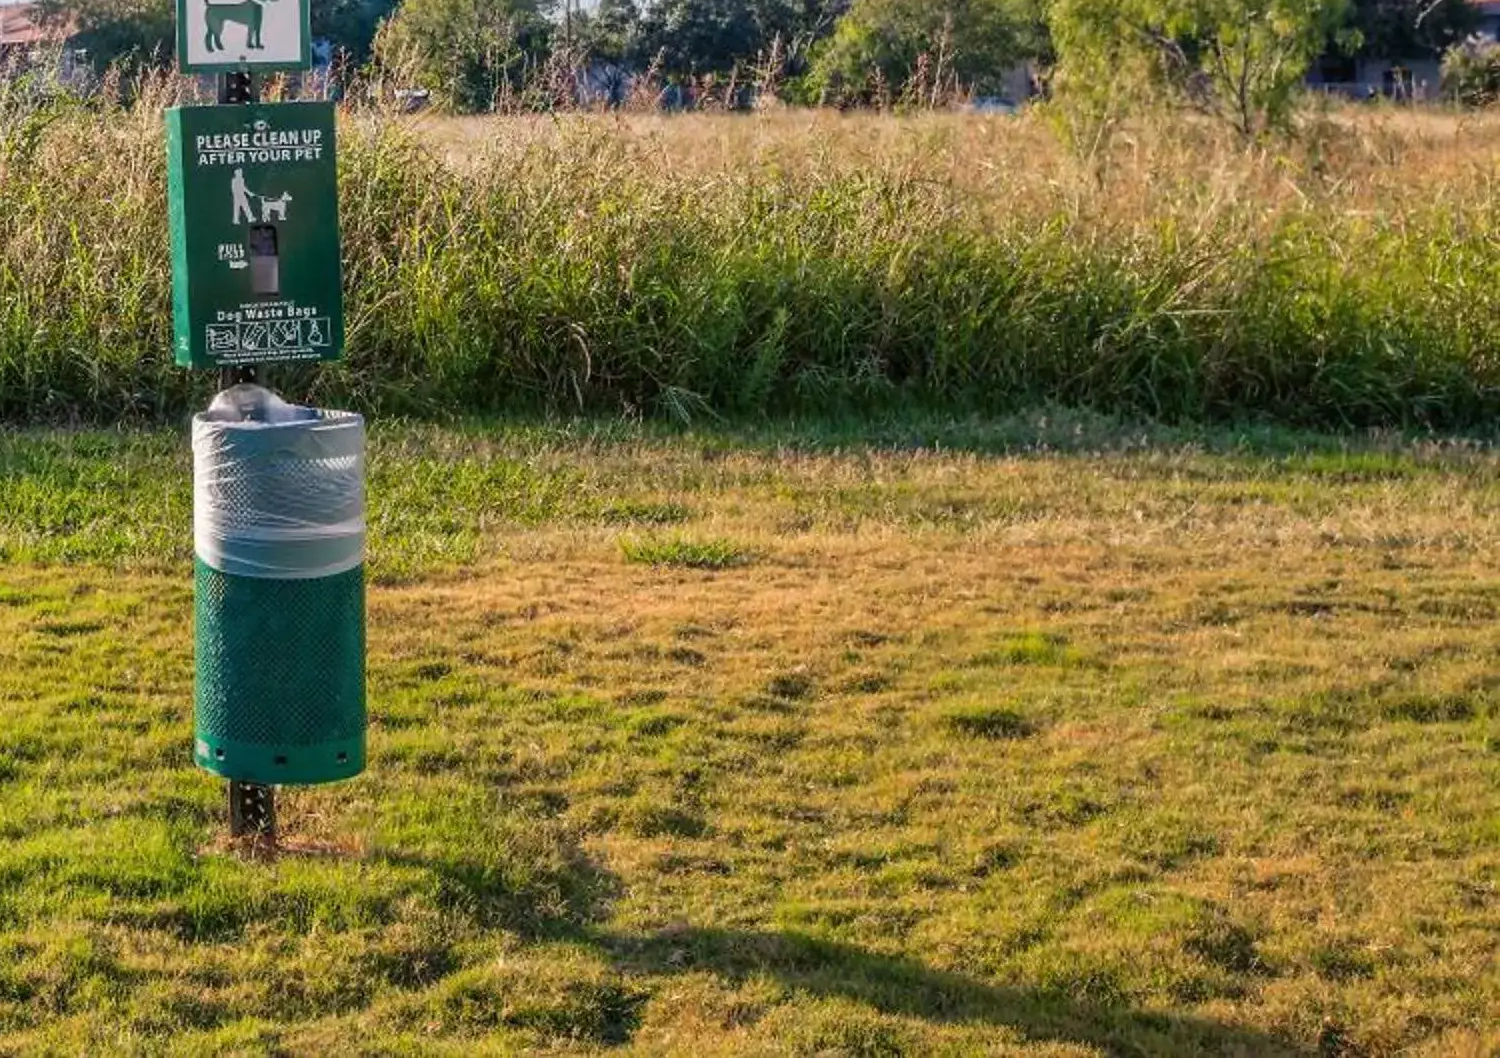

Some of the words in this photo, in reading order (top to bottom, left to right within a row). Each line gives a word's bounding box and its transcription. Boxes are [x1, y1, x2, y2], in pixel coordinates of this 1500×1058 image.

[197, 134, 249, 149] PLEASE
[253, 132, 298, 146] CLEAN
[302, 129, 322, 144] UP
[198, 151, 245, 165] AFTER
[249, 149, 291, 163] YOUR
[295, 147, 322, 161] PET
[217, 311, 242, 322] Dog
[245, 307, 283, 319] Waste
[287, 307, 317, 318] Bags
